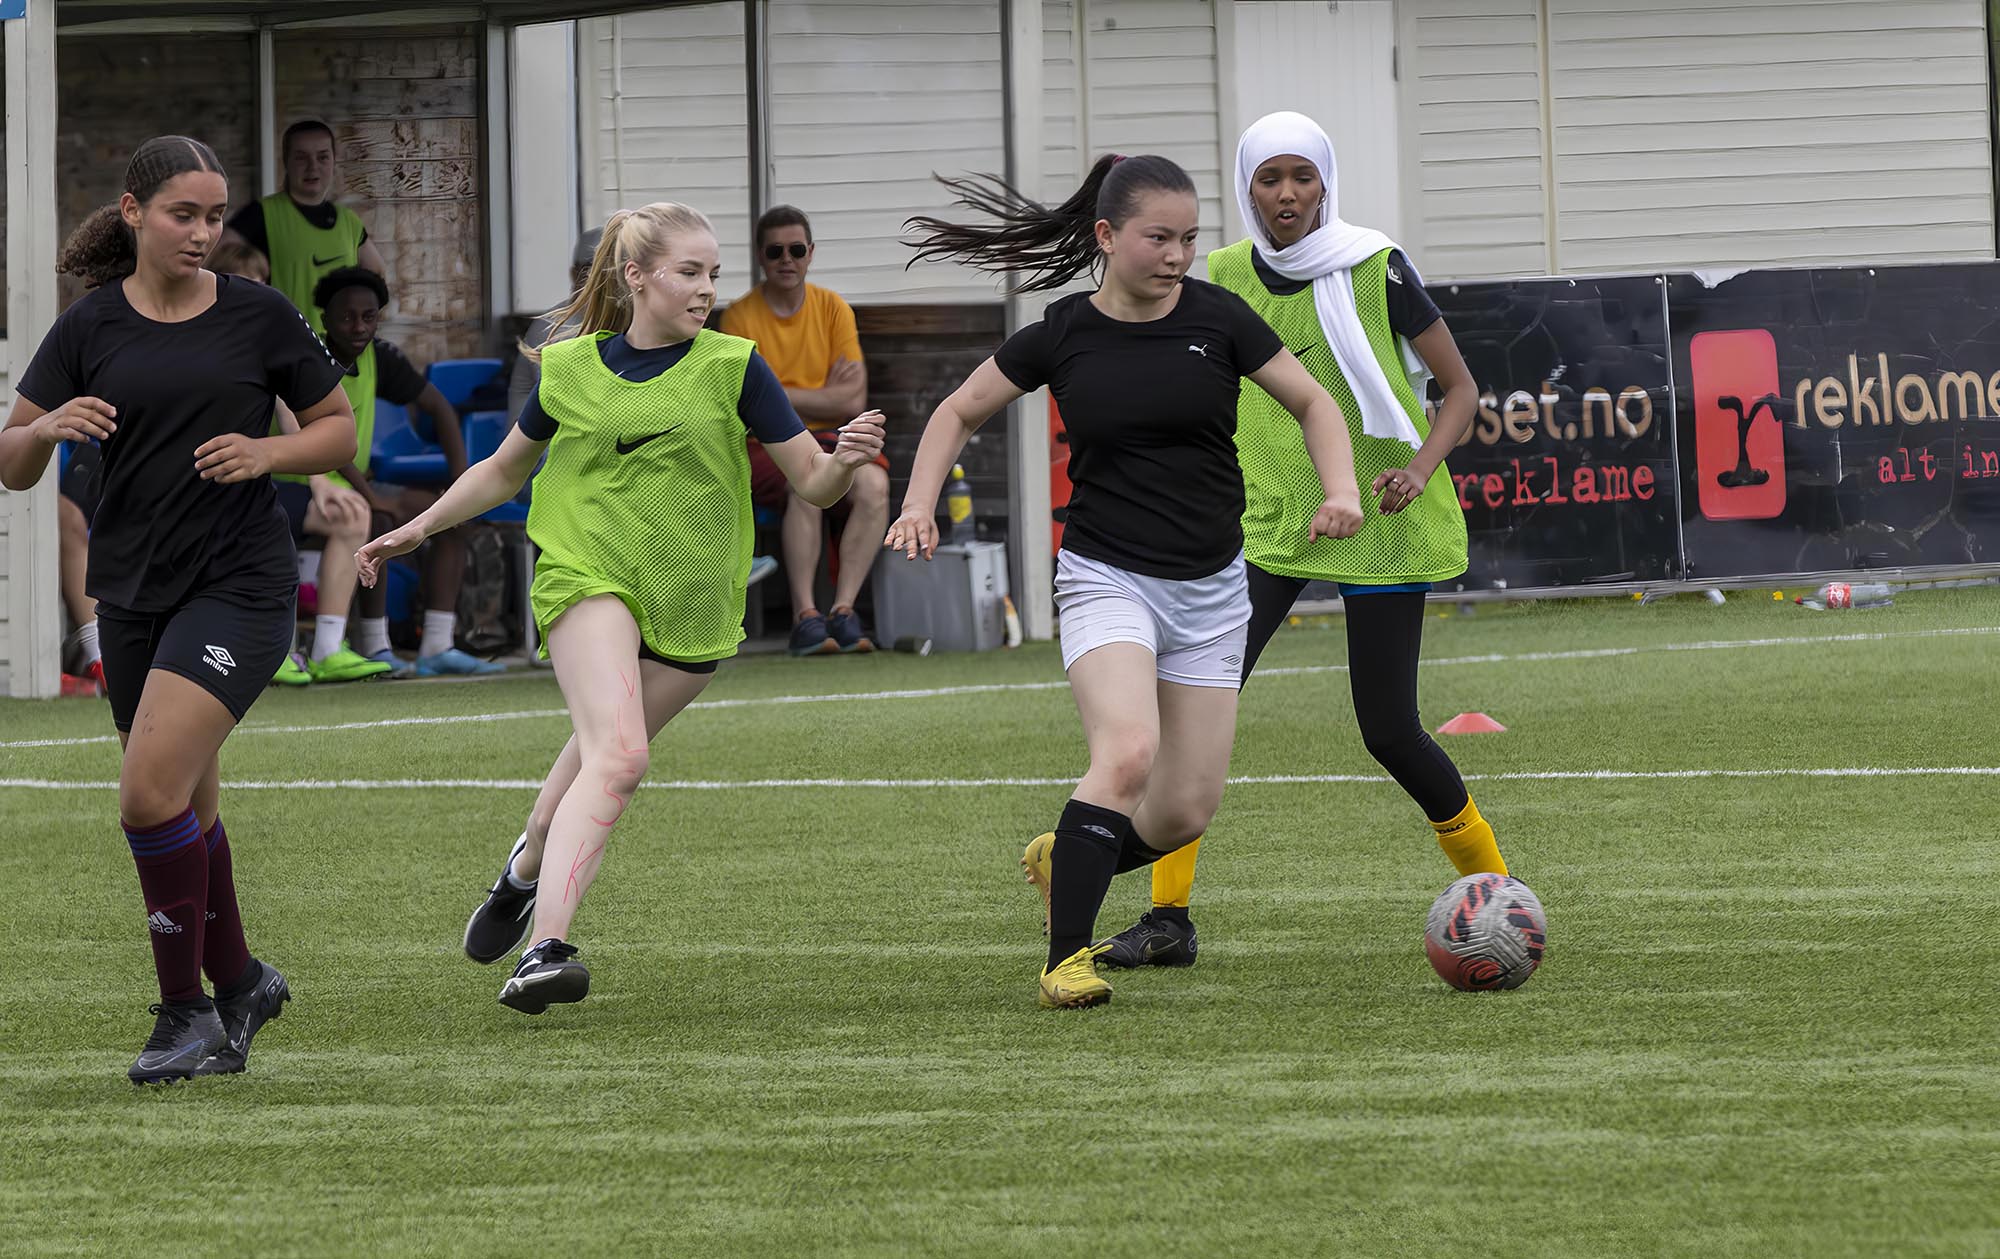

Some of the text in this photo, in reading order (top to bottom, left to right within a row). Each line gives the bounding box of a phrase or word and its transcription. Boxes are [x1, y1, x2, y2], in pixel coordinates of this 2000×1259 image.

[1426, 380, 1653, 447] set.no
[1453, 456, 1656, 511] reklame
[1878, 447, 1937, 484] alt
[202, 654, 229, 676] umbro
